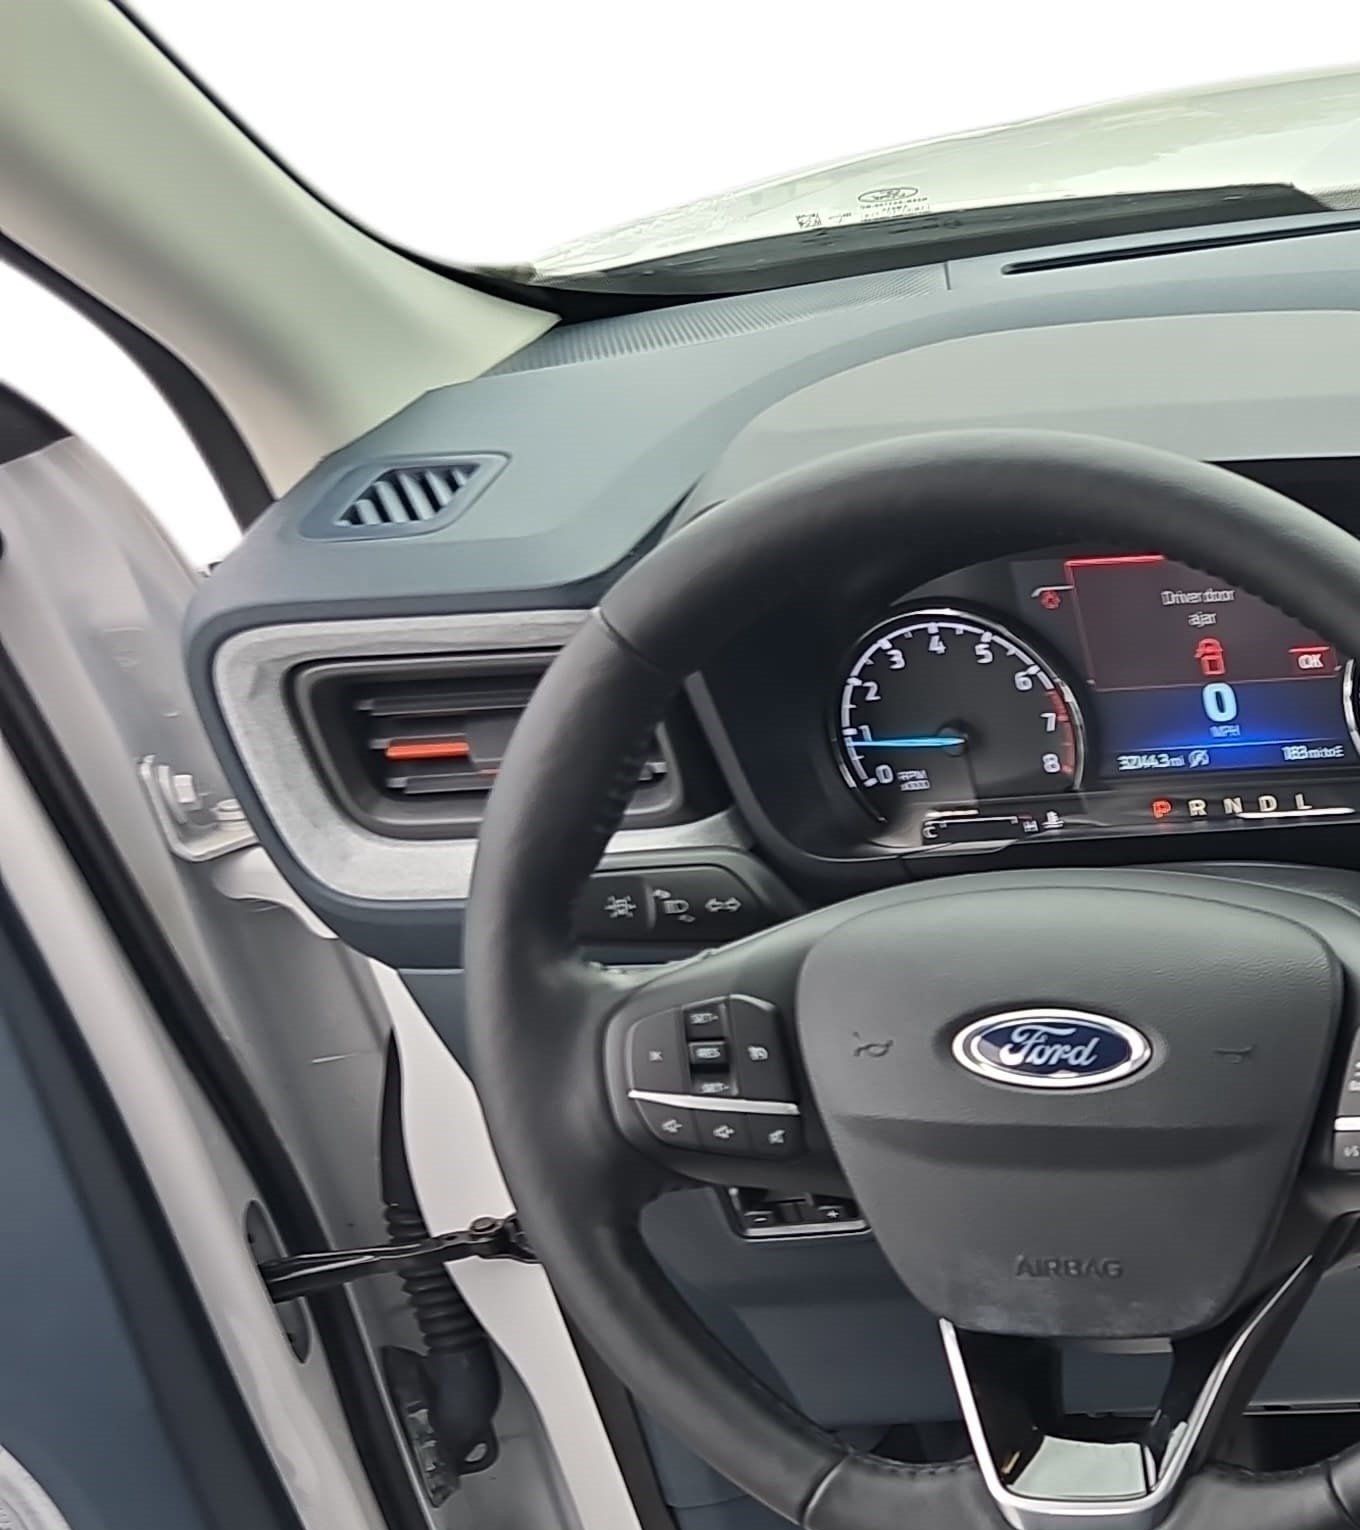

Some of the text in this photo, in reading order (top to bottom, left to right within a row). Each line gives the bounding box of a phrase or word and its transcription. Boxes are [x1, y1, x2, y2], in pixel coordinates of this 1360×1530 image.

[1160, 588, 1236, 606] Driver door
[1188, 611, 1217, 627] ajar
[929, 636, 946, 654] 4
[975, 644, 993, 664] 5
[886, 650, 905, 669] 3
[1298, 654, 1324, 669] OK
[1015, 672, 1033, 690] 6
[862, 682, 881, 701] 2
[1202, 682, 1237, 722] 0
[1040, 713, 1057, 731] 7
[859, 725, 873, 741] 1
[1042, 753, 1060, 772] 8
[876, 765, 893, 783] 0
[1152, 793, 1312, 818] P R N D L
[1000, 1024, 1100, 1066] Ford
[1016, 1254, 1123, 1279] AIRBAG
